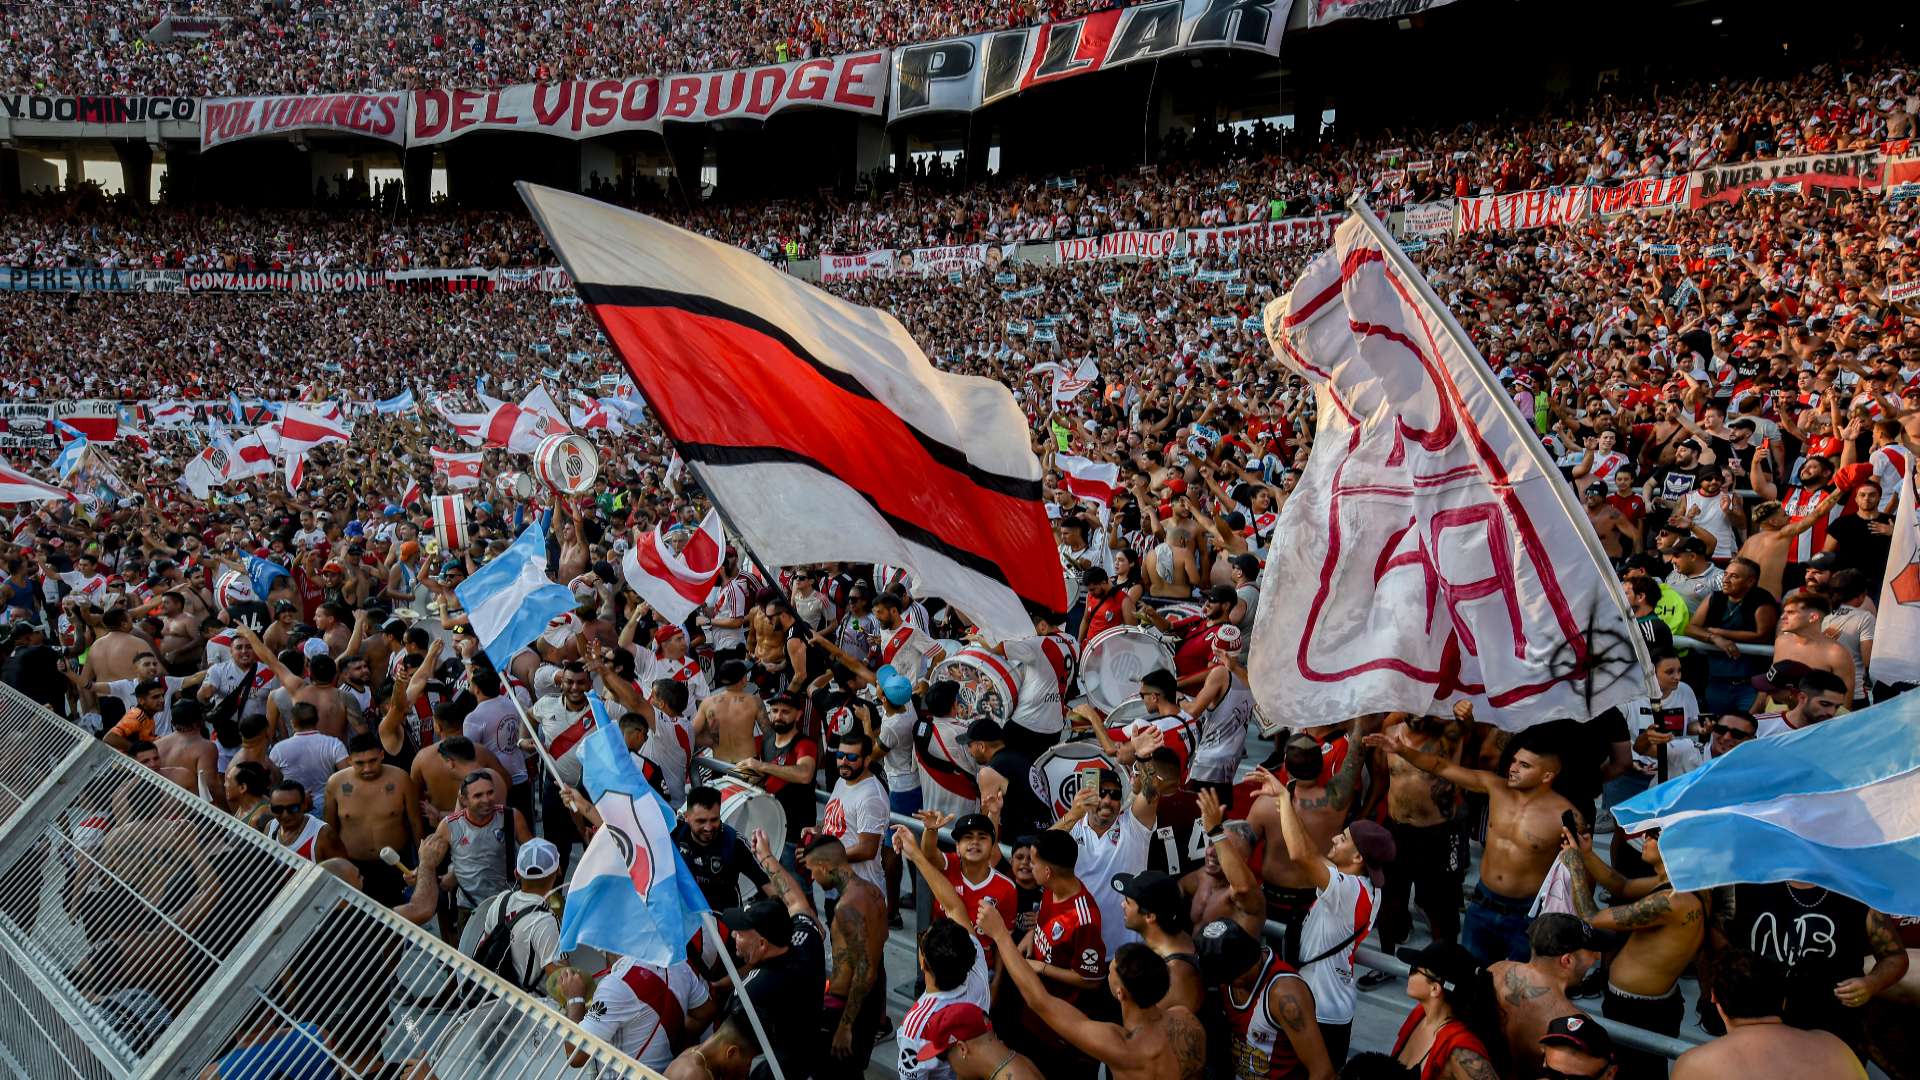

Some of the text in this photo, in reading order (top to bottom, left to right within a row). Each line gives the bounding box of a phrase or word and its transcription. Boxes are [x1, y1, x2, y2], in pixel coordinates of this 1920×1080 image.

[415, 79, 660, 138] DEL VISO
[662, 53, 881, 117] BUDGE
[204, 97, 400, 145] POLVORINES
[1784, 160, 1808, 177] SU
[10, 269, 121, 290] PEREYRA
